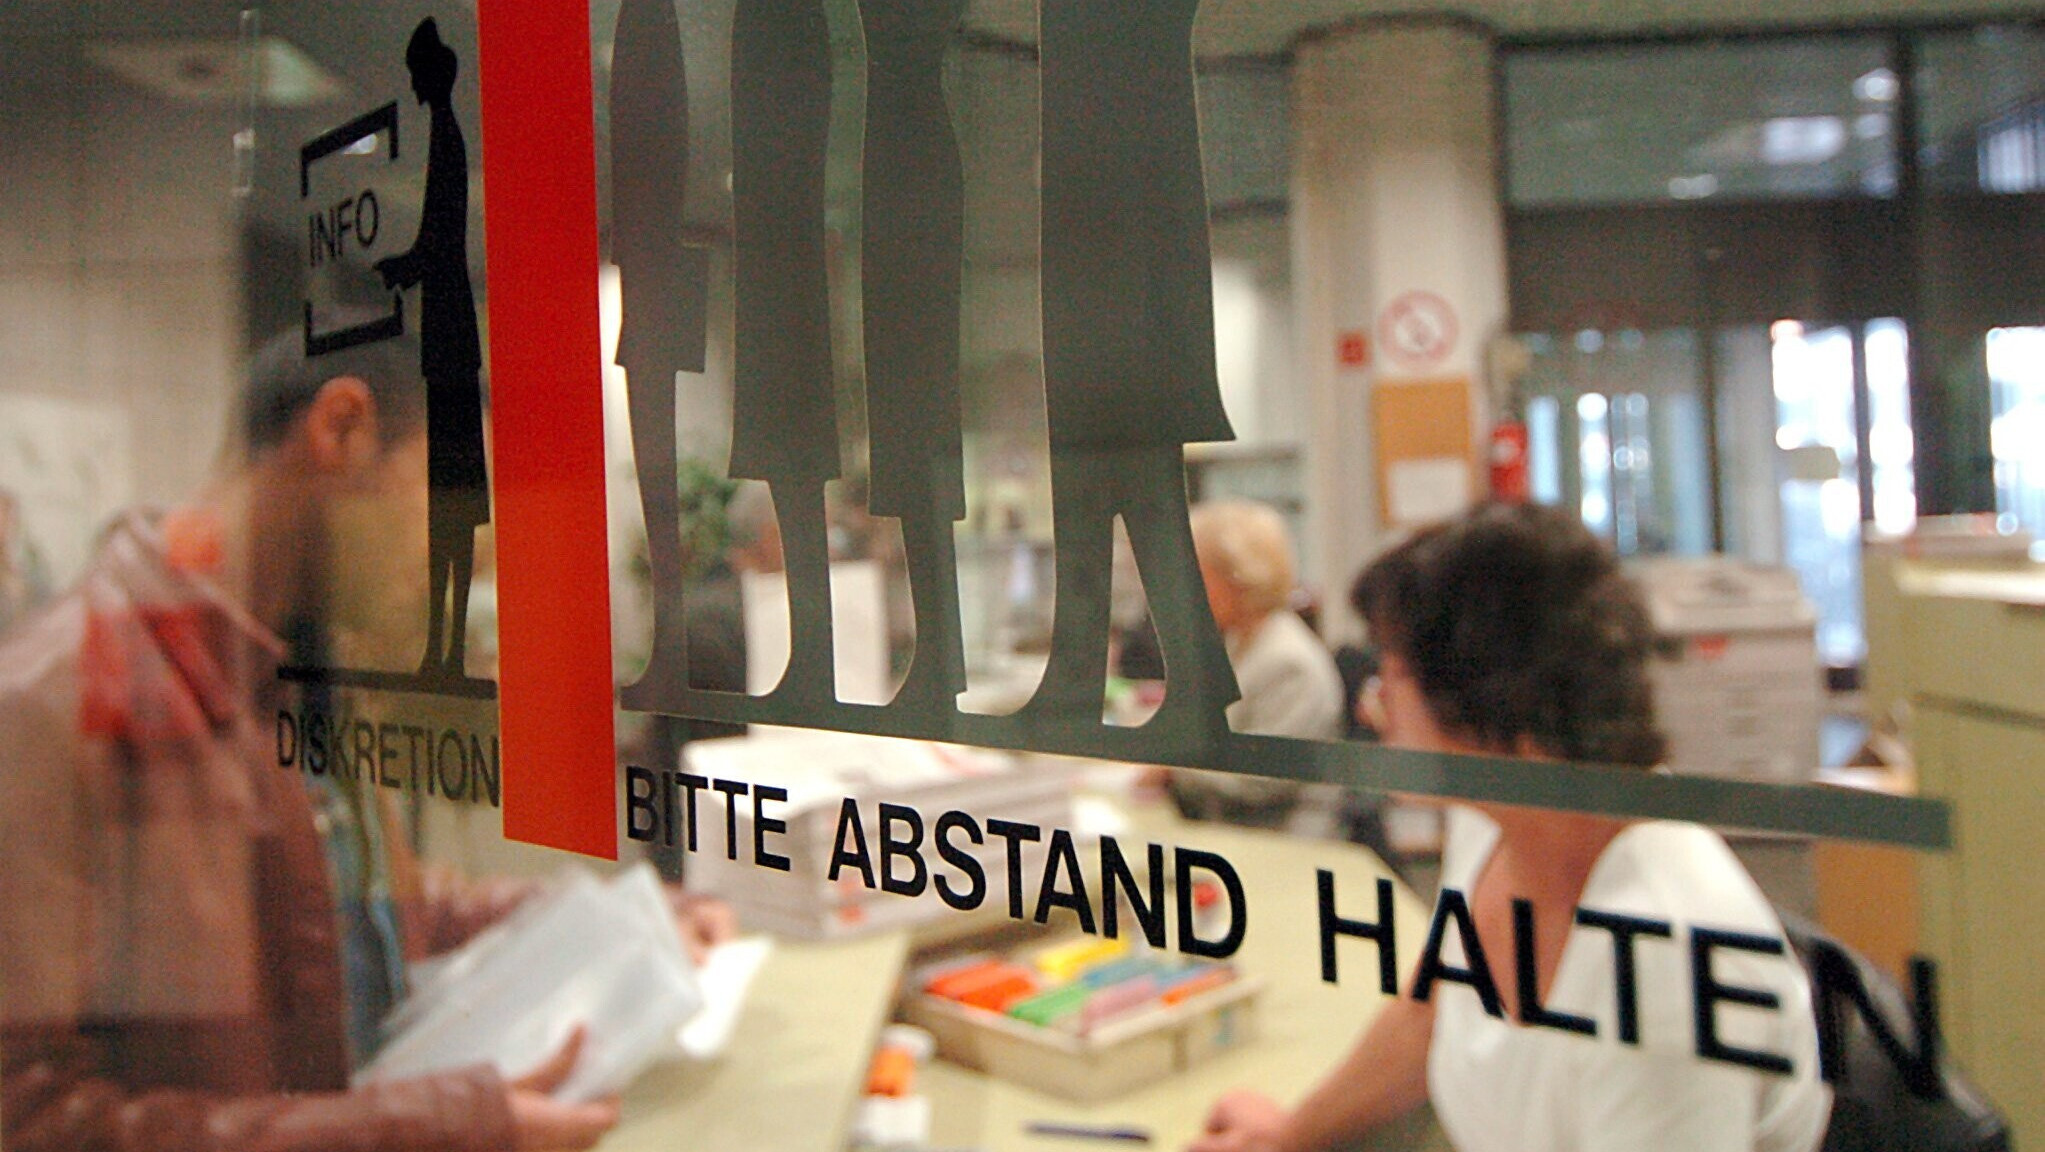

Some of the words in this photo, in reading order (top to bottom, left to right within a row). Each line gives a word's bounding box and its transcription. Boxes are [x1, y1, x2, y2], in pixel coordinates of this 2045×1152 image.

[308, 188, 379, 268] INFO
[276, 709, 500, 807] DISKRETION
[626, 765, 791, 872] BITTE
[827, 797, 1247, 960] ABSTAND
[1316, 868, 1946, 1102] HALTEN
